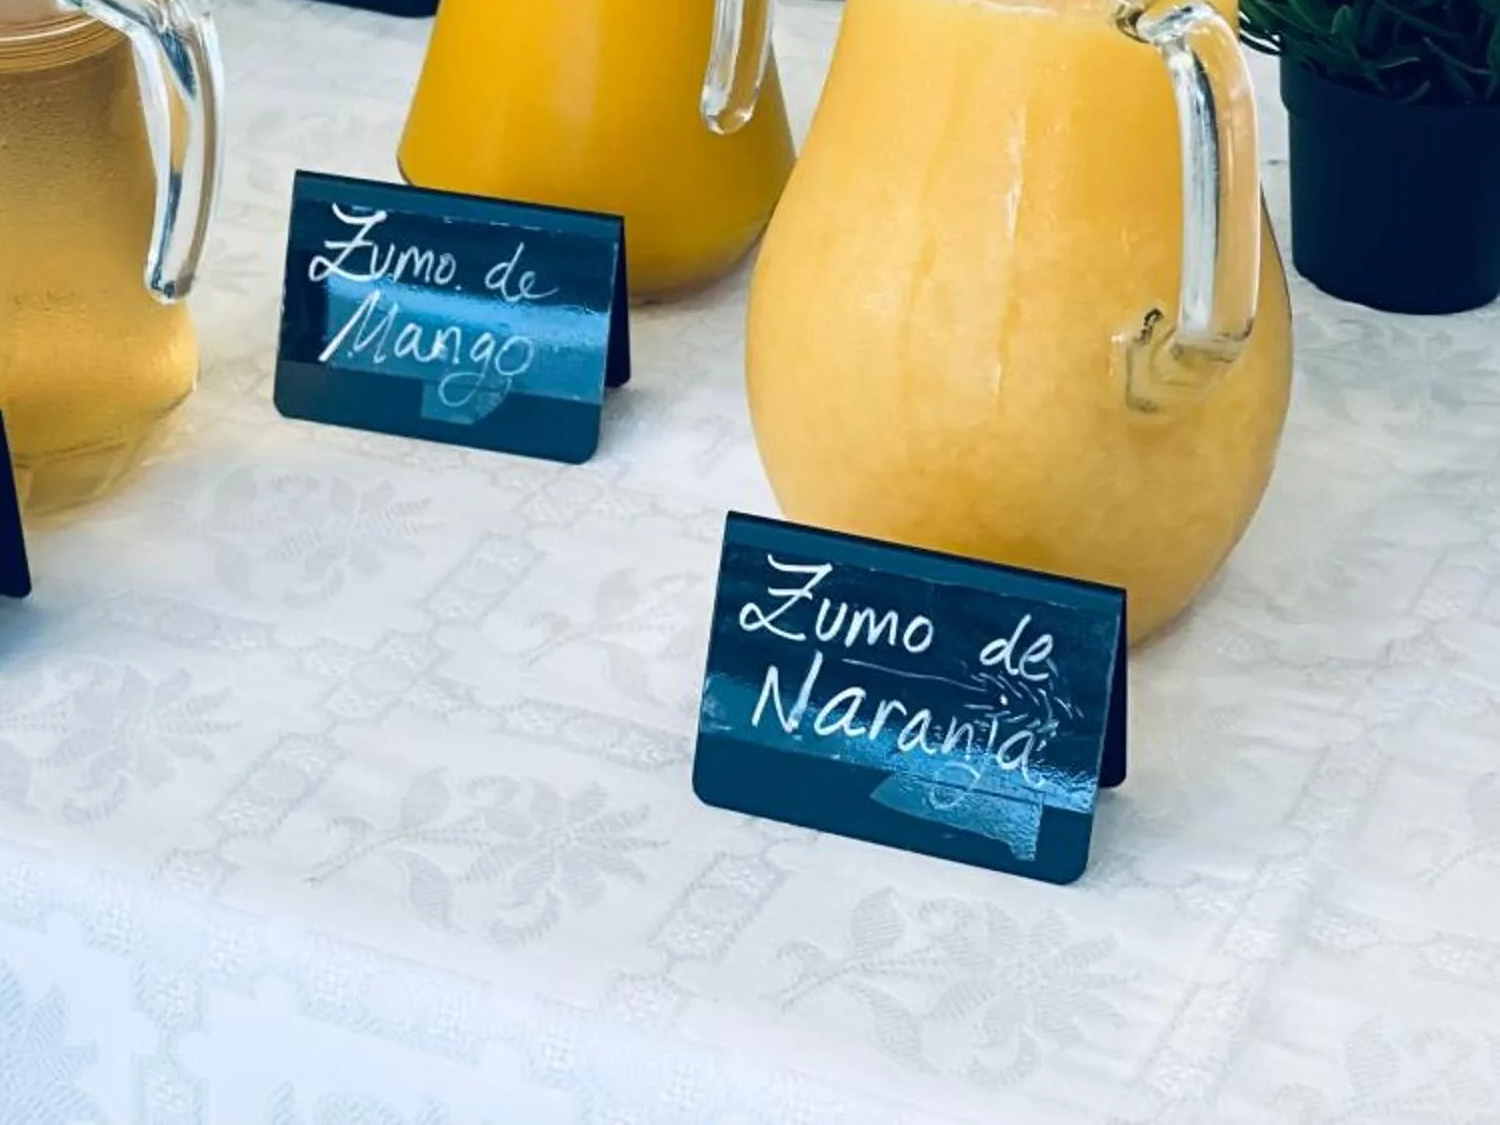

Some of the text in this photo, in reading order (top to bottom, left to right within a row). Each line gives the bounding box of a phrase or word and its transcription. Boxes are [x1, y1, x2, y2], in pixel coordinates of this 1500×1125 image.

[484, 241, 559, 303] de
[318, 289, 535, 407] Mango
[739, 553, 1055, 682] Zumo de
[750, 650, 1046, 811] Naranja
